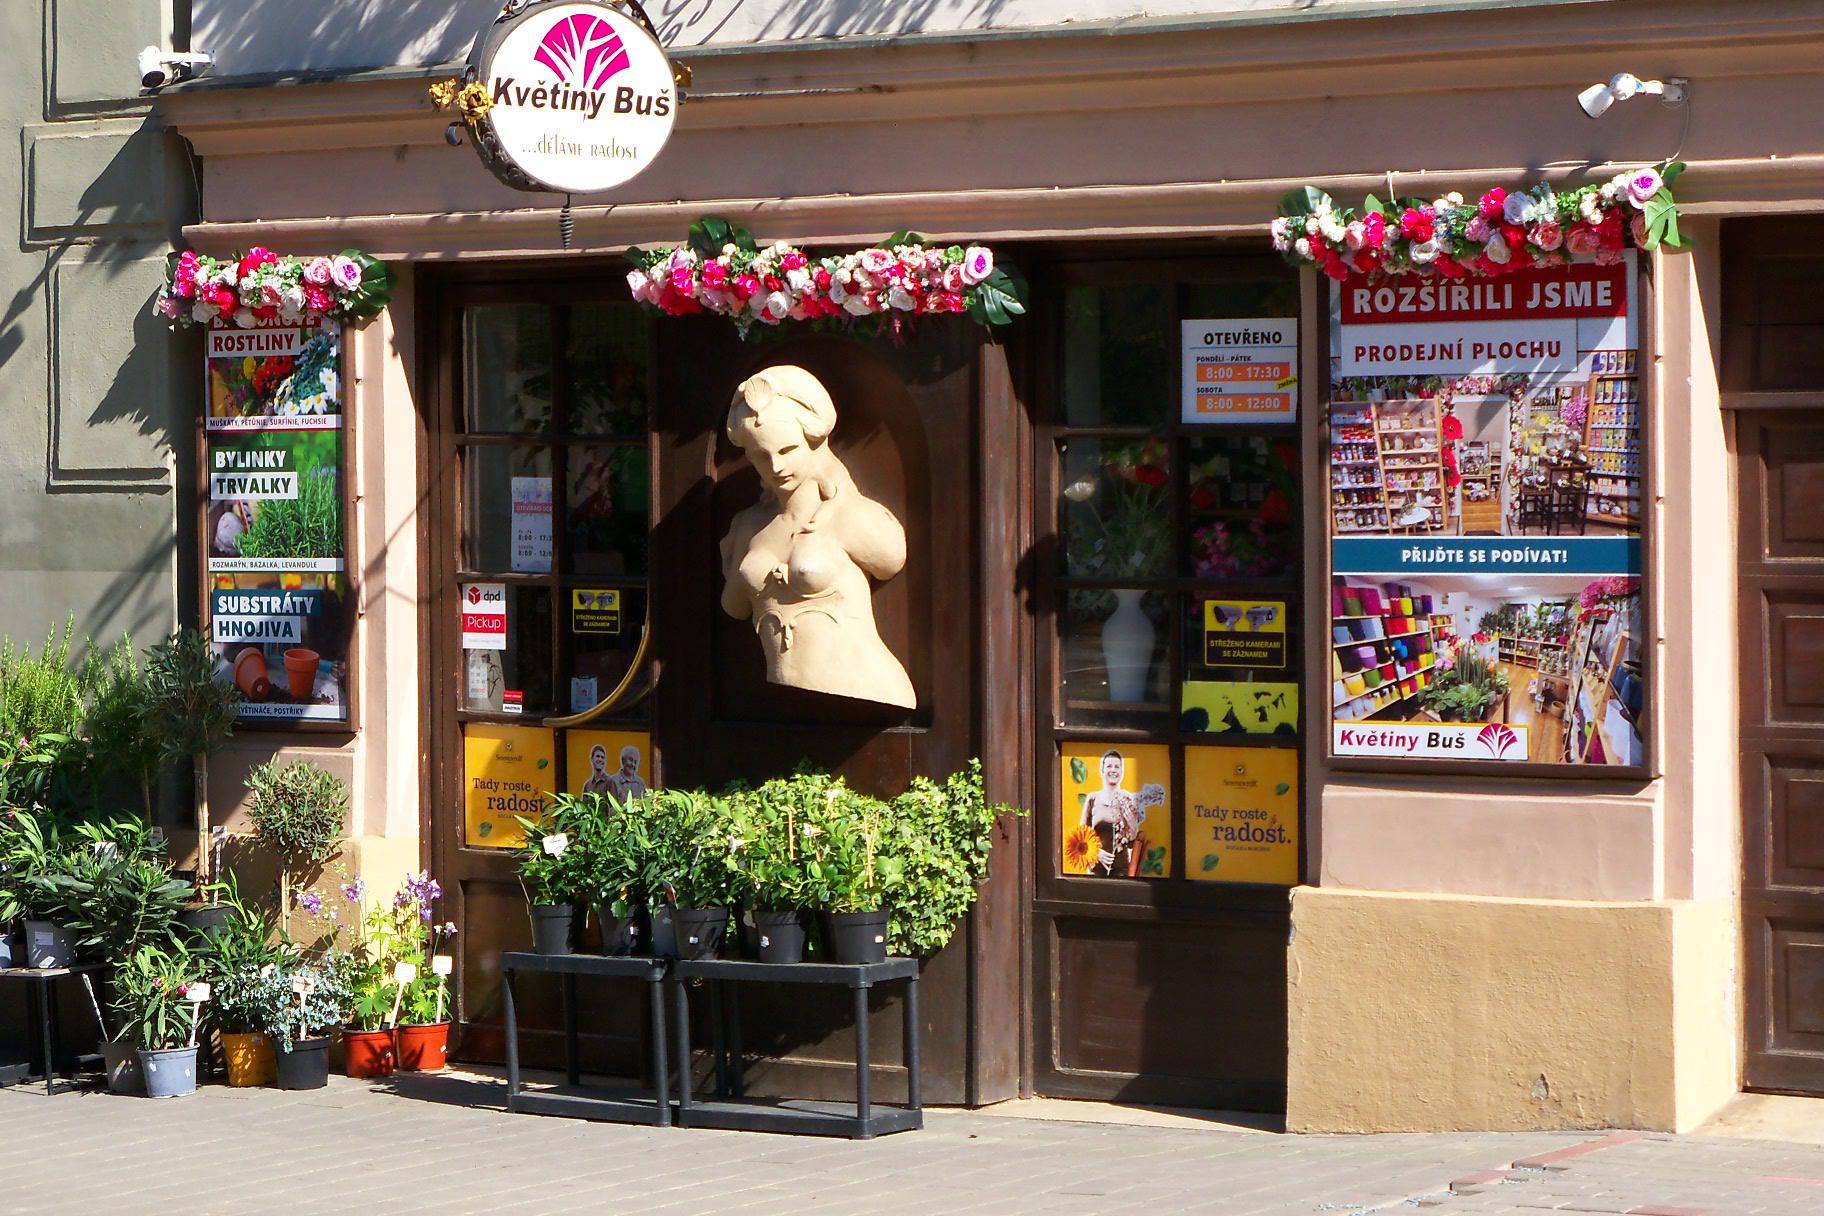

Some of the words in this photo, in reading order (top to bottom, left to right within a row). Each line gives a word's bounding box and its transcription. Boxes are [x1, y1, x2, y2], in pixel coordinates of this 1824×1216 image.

[493, 77, 606, 119] Květiny
[613, 86, 670, 117] Buš
[1353, 279, 1513, 314] ROZŠÍŘILI
[1527, 280, 1613, 309] JSME
[213, 333, 295, 352] ROSTLINY
[1203, 328, 1283, 345] OTEVŘENO
[1354, 338, 1463, 362] PRODEJNÍ
[1472, 340, 1562, 360] PLOCHU
[1206, 367, 1233, 379] 8:00
[1246, 366, 1281, 379] 17:30
[1206, 398, 1233, 409] 8:00
[1246, 397, 1281, 409] 12:00
[302, 417, 327, 425] FUCHSIE
[215, 450, 287, 468] BYLINKY
[216, 477, 292, 495] TRVALKY
[1402, 546, 1464, 563] PŘIJĎTE
[1469, 549, 1486, 563] SE
[1491, 546, 1568, 563] PODÍVAT!
[212, 559, 248, 569] ROZMARÝN,
[281, 560, 318, 569] LEVANDULE
[218, 592, 314, 614] SUBSTRÁTY
[483, 590, 501, 604] dpd
[218, 620, 294, 638] HNOJIVA
[467, 616, 501, 631] Pickup
[1210, 639, 1244, 648] STŘEŽENO
[1245, 640, 1281, 649] KAMERAMI
[1223, 650, 1231, 658] SE
[274, 705, 304, 715] POSTŘIKY
[1340, 729, 1420, 752] Květiny
[1427, 732, 1466, 749] Buš
[473, 777, 500, 792] Tady
[503, 780, 531, 792] roste
[1194, 805, 1229, 821] Tady
[1232, 807, 1268, 820] roste
[1212, 821, 1292, 844] radost.
